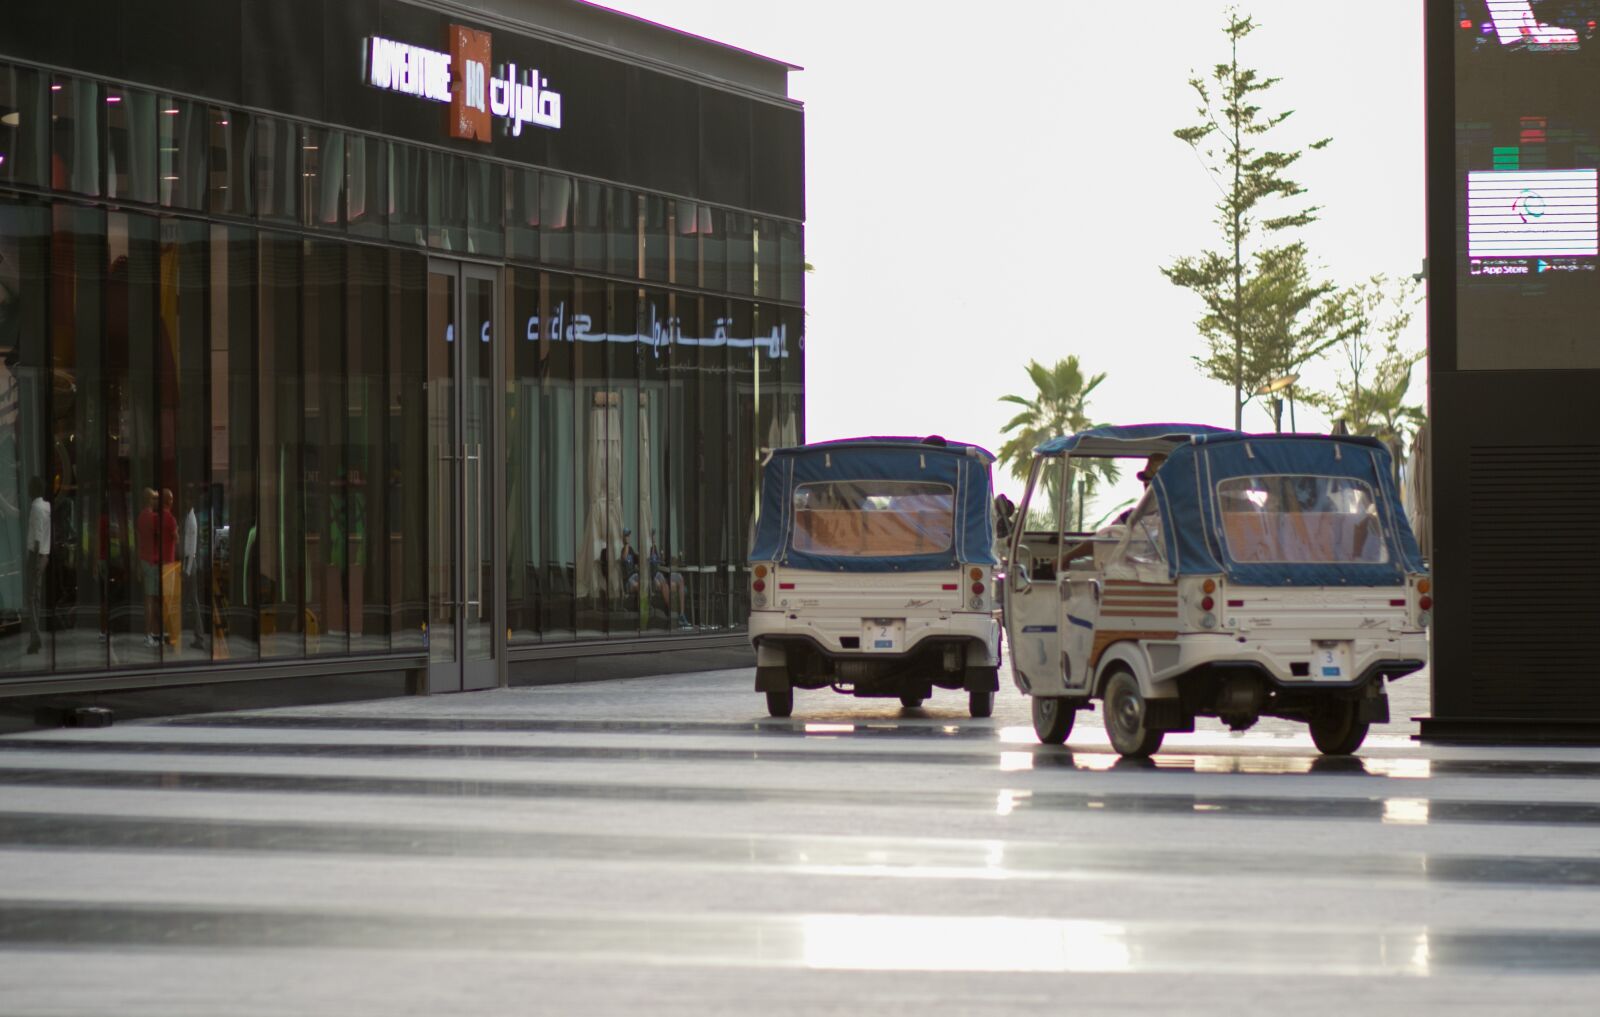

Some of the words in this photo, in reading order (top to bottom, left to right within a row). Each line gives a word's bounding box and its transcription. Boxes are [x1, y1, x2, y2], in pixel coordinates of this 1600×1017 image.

[371, 36, 452, 103] ADVENTURE
[466, 58, 486, 113] HQ
[1502, 265, 1529, 274] Store
[880, 626, 888, 638] 2
[1326, 650, 1334, 664] 3
